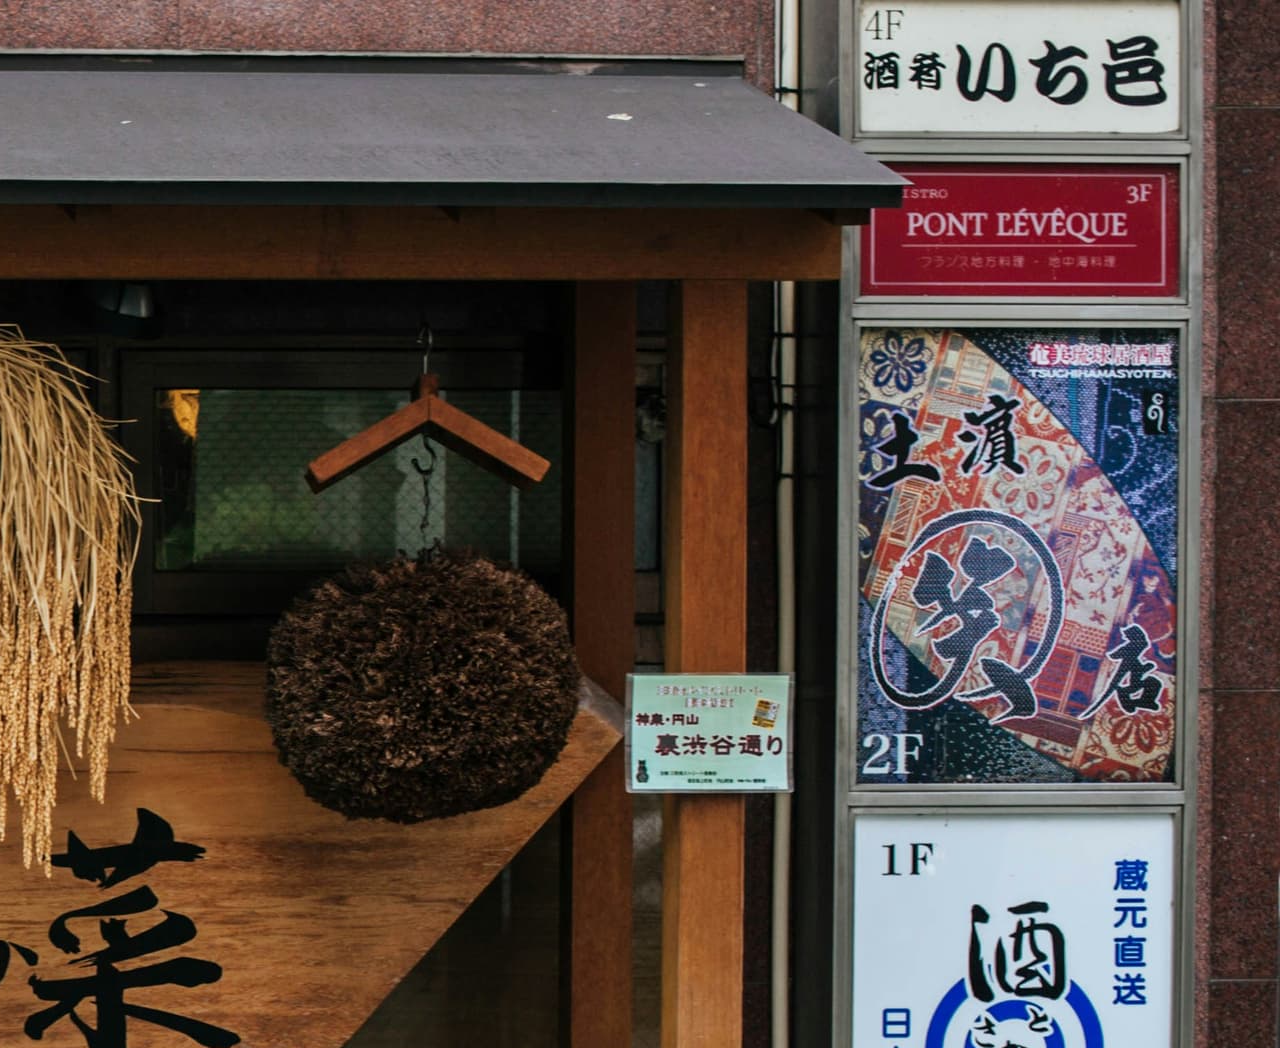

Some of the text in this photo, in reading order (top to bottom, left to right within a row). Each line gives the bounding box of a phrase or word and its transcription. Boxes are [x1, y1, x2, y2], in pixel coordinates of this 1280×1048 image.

[865, 9, 904, 41] 4F
[864, 35, 1169, 107] 酒肴 いち邑
[902, 188, 949, 199] ISTRO
[1126, 184, 1154, 204] 3F
[906, 211, 989, 237] PONT
[655, 733, 783, 756] 裏渋谷通り
[861, 733, 925, 776] 2F
[880, 842, 935, 877] 1F
[1112, 859, 1149, 1006] 蔵元直送
